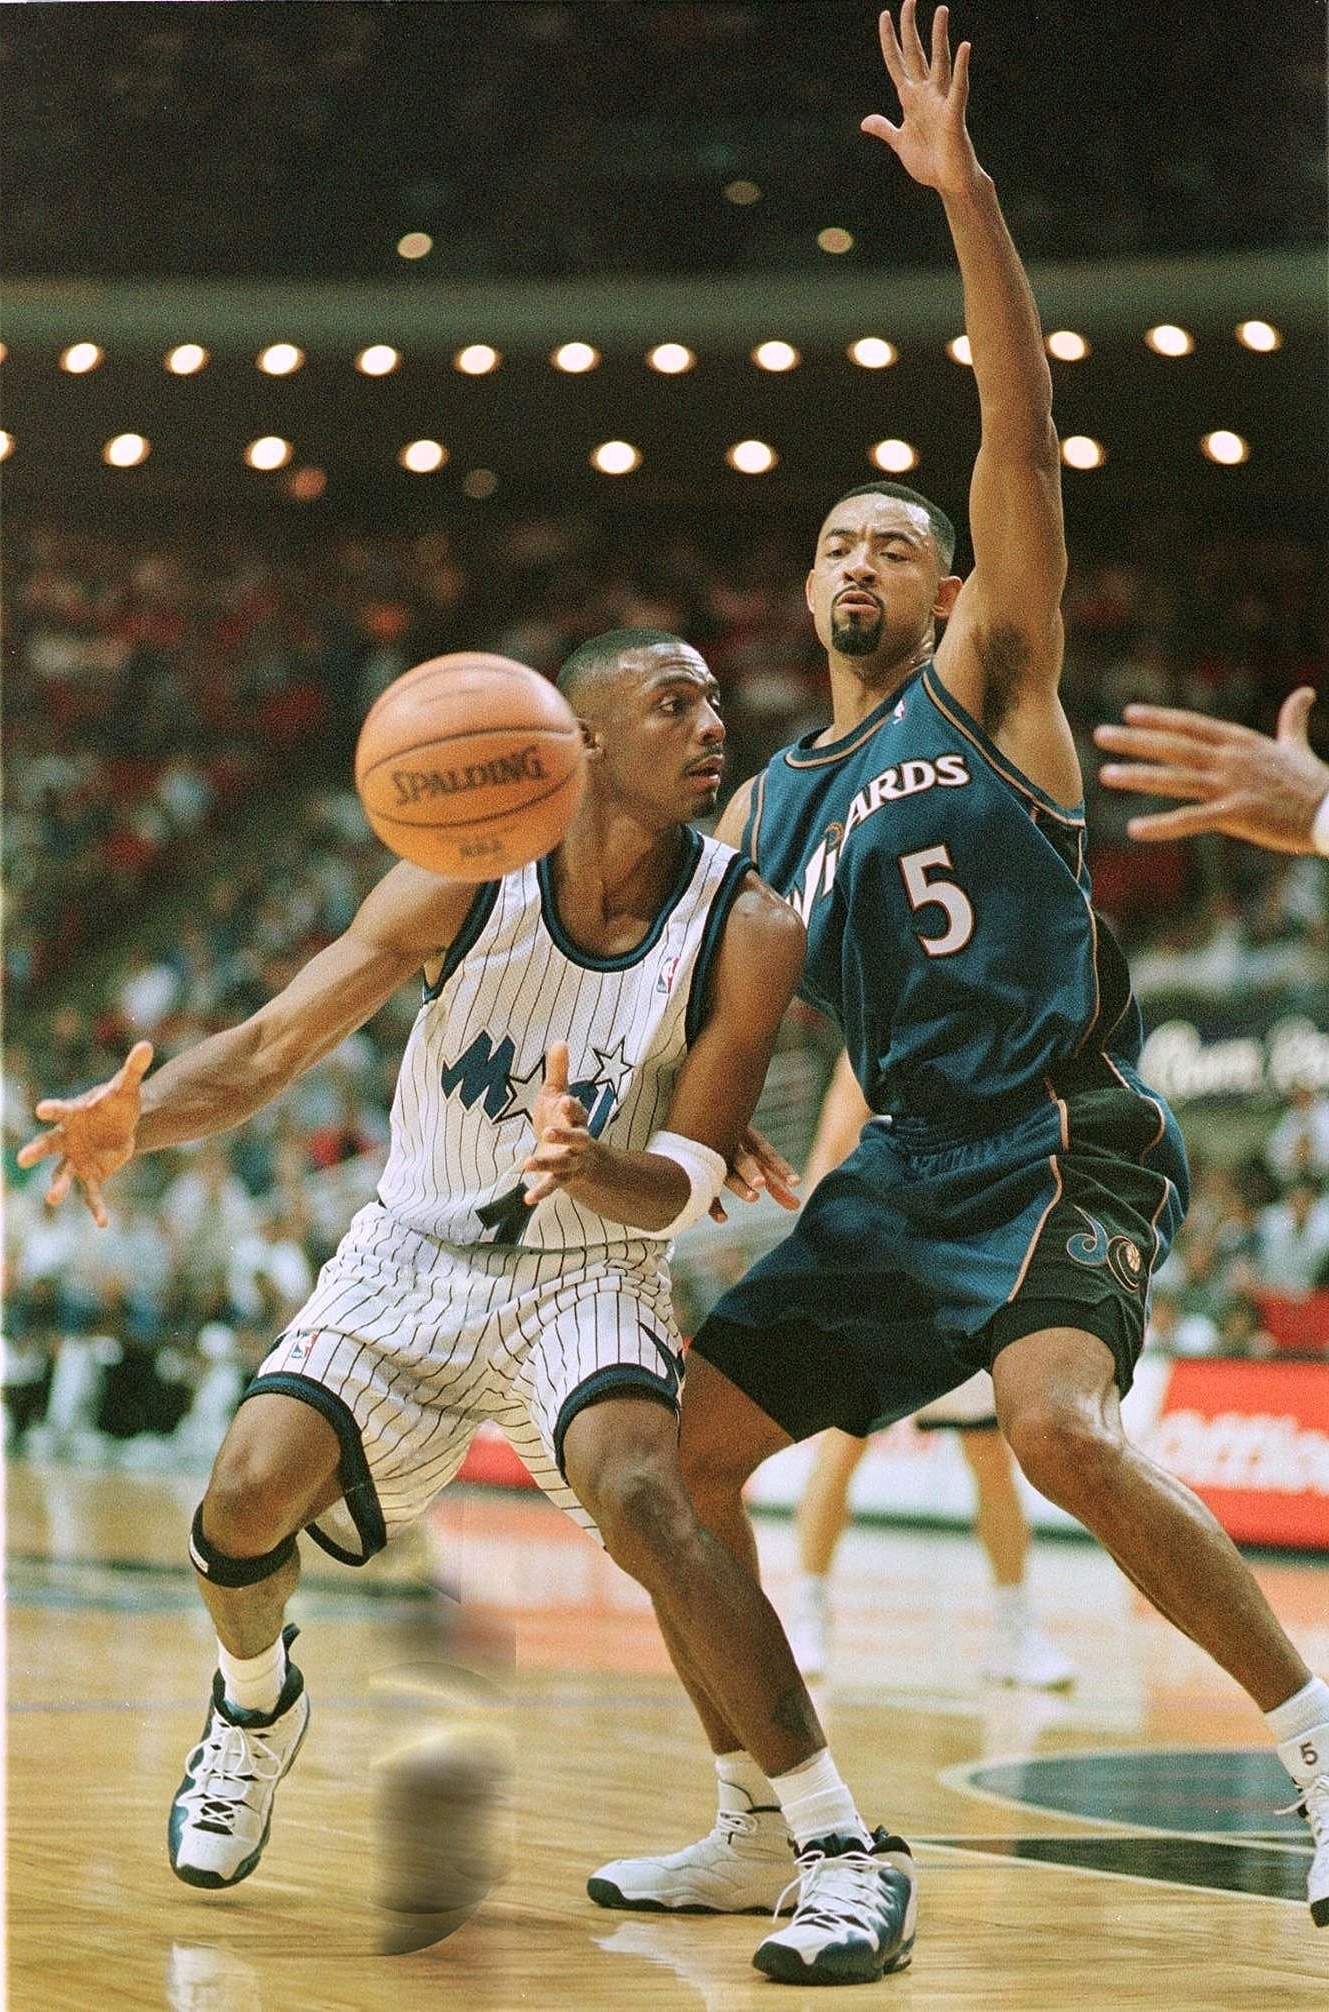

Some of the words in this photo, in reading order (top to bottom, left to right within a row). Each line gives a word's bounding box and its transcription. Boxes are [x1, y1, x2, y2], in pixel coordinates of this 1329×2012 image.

[391, 743, 545, 806] SPALDING
[899, 844, 977, 957] 5
[1299, 1741, 1319, 1766] 5
